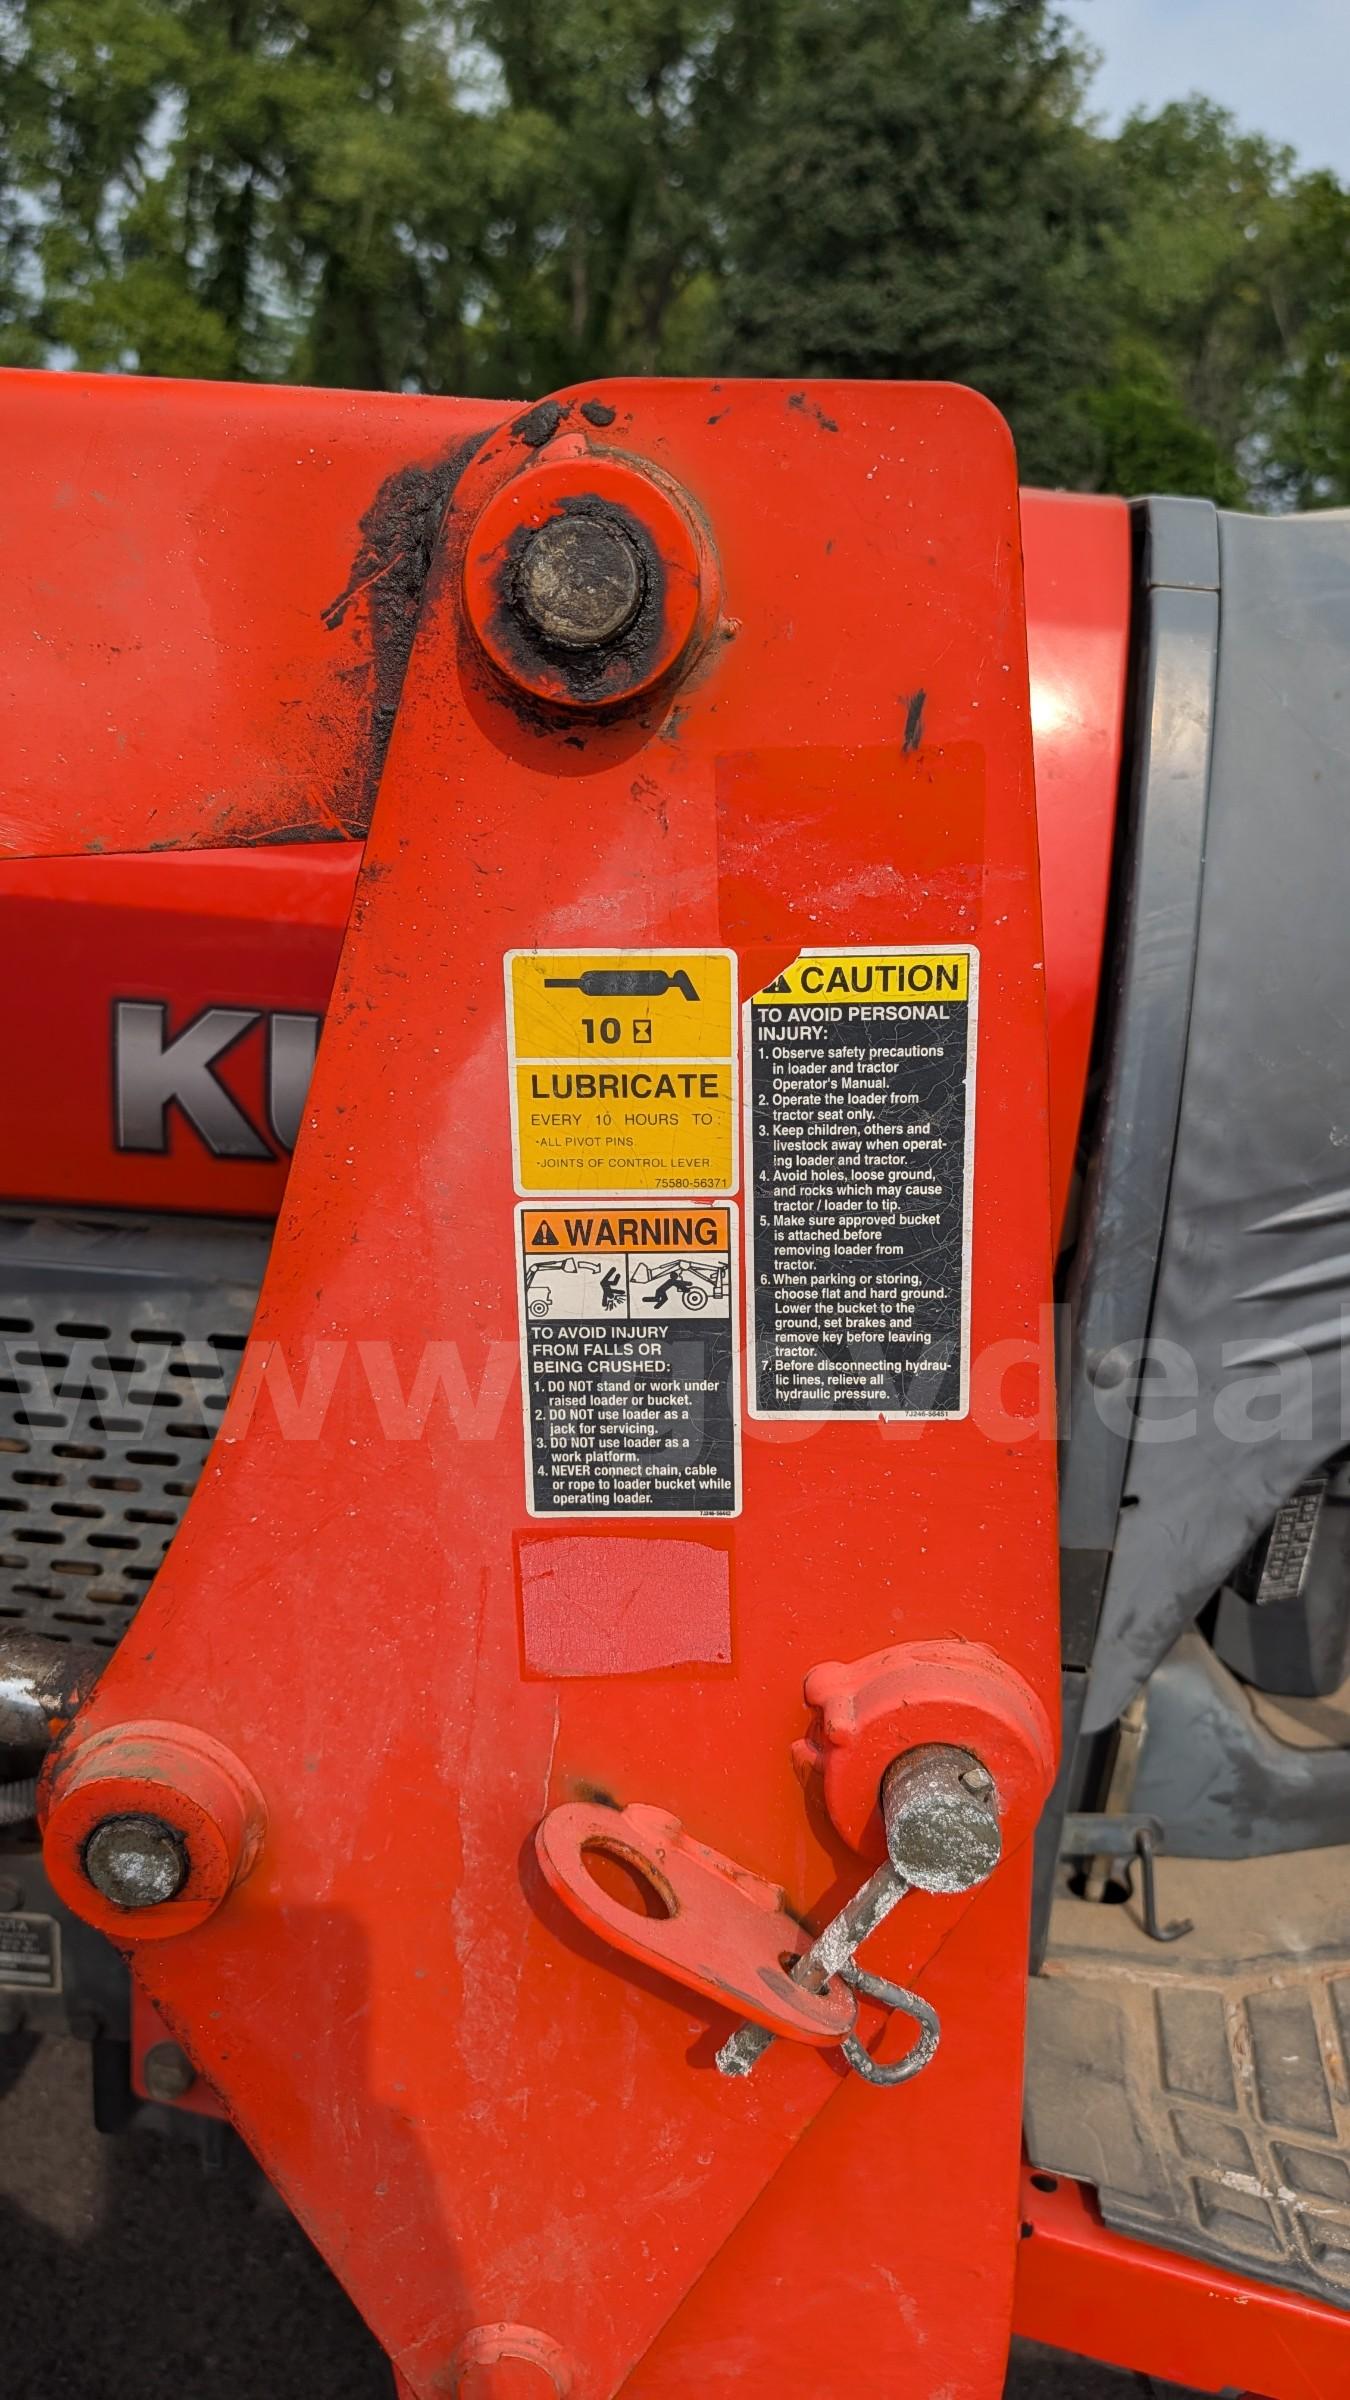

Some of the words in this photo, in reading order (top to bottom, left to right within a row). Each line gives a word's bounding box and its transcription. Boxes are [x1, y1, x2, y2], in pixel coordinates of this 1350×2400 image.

[800, 964, 959, 993] CAUTION
[758, 1008, 782, 1022] TO
[788, 1008, 842, 1022] AVOID
[849, 1006, 949, 1021] PERSONAL
[581, 1018, 621, 1044] 10
[758, 1026, 828, 1041] INJURY:
[772, 1047, 824, 1059] Observe
[828, 1046, 865, 1060] safety
[869, 1045, 944, 1060] precautions
[773, 1063, 783, 1074] in
[788, 1063, 827, 1074] loader
[830, 1062, 853, 1073] and
[857, 1062, 899, 1073] tractor
[532, 1074, 719, 1098] LUBRICATE
[773, 1078, 837, 1091] Operator's
[842, 1078, 890, 1089] Manual.
[772, 1094, 821, 1107] Operate
[825, 1094, 845, 1105] the
[848, 1093, 888, 1104] loader
[890, 1093, 919, 1104] from
[531, 1114, 581, 1126] EVERY
[596, 1114, 611, 1126] 10
[625, 1114, 679, 1126] HOURS
[773, 1110, 814, 1121] tractor
[817, 1110, 843, 1121] seat
[847, 1109, 875, 1122] only.
[773, 1125, 804, 1139] Keep
[808, 1125, 860, 1137] children,
[864, 1124, 903, 1135] others
[907, 1123, 930, 1134] and
[565, 1137, 600, 1147] PIVOT
[774, 1140, 828, 1151] livestock
[831, 1141, 862, 1153] away
[866, 1140, 899, 1150] when
[903, 1139, 947, 1152] operat-
[588, 1158, 605, 1168] OF
[609, 1158, 666, 1168] CONTROL
[774, 1155, 792, 1168] ing
[796, 1155, 834, 1166] loader
[838, 1155, 861, 1166] and
[864, 1155, 908, 1165] tractor.
[773, 1171, 807, 1182] Avoid
[811, 1170, 848, 1182] holes,
[851, 1170, 885, 1181] loose
[888, 1169, 935, 1183] ground,
[655, 1179, 727, 1188] 75580-56371
[774, 1185, 796, 1196] and
[800, 1185, 833, 1195] rocks
[837, 1184, 873, 1195] which
[876, 1186, 901, 1198] may
[905, 1185, 942, 1195] cause
[774, 1200, 814, 1211] tractor
[824, 1200, 862, 1210] loader
[866, 1200, 878, 1210] to
[882, 1200, 900, 1212] tip.
[774, 1215, 805, 1226] Make
[809, 1217, 835, 1225] sure
[839, 1215, 895, 1229] approved
[900, 1214, 941, 1225] bucket
[564, 1218, 718, 1245] WARNING
[774, 1230, 784, 1241] is
[788, 1230, 841, 1241] attached
[843, 1229, 882, 1240] before
[774, 1245, 831, 1258] removing
[834, 1244, 872, 1254] loader
[876, 1244, 904, 1254] from
[774, 1260, 816, 1270] tractor.
[773, 1274, 807, 1284] When
[811, 1274, 855, 1287] parking
[860, 1276, 873, 1284] or
[876, 1274, 922, 1287] storing,
[775, 1289, 818, 1299] choose
[822, 1289, 841, 1299] flat
[844, 1288, 866, 1298] and
[870, 1288, 897, 1298] hard
[900, 1288, 948, 1301] ground.
[775, 1303, 811, 1314] Lower
[815, 1303, 834, 1314] the
[837, 1303, 877, 1313] bucket
[881, 1303, 892, 1313] to
[896, 1303, 915, 1313] the
[775, 1318, 821, 1330] ground,
[824, 1318, 843, 1328] set
[846, 1318, 886, 1328] brakes
[889, 1317, 911, 1327] and
[531, 1327, 554, 1339] TO
[558, 1327, 607, 1339] AVOID
[611, 1326, 669, 1339] INJURY
[775, 1333, 819, 1343] remove
[823, 1332, 843, 1345] key
[846, 1332, 885, 1342] before
[889, 1332, 931, 1344] leaving
[532, 1344, 580, 1356] FROM
[584, 1344, 633, 1356] FALLS
[638, 1344, 661, 1355] OR
[776, 1346, 817, 1357] tractor.
[533, 1361, 583, 1373] BEING
[588, 1361, 671, 1373] CRUSHED:
[775, 1360, 814, 1371] Before
[817, 1360, 902, 1373] disconnecting
[905, 1360, 951, 1373] hydrau-
[548, 1381, 564, 1392] DO
[569, 1381, 593, 1392] NOT
[597, 1381, 630, 1392] stand
[634, 1383, 647, 1392] or
[650, 1381, 681, 1391] work
[684, 1380, 719, 1391] under
[776, 1375, 789, 1385] lic
[793, 1375, 824, 1386] lines,
[827, 1375, 867, 1385] relieve
[870, 1374, 884, 1384] all
[549, 1395, 586, 1406] raised
[590, 1395, 629, 1406] loader
[632, 1397, 644, 1406] or
[648, 1394, 692, 1406] bucket.
[776, 1389, 830, 1401] hydraulic
[834, 1390, 890, 1400] pressure.
[550, 1409, 566, 1421] DO
[570, 1409, 593, 1421] NOT
[598, 1412, 619, 1421] use
[623, 1409, 660, 1420] loader
[664, 1411, 678, 1420] as
[550, 1423, 575, 1435] jack
[579, 1423, 596, 1434] for
[599, 1423, 658, 1435] servicing.
[550, 1437, 566, 1448] DO
[570, 1437, 595, 1448] NOT
[599, 1439, 620, 1448] use
[623, 1437, 661, 1448] loader
[665, 1439, 678, 1448] as
[552, 1451, 581, 1462] work
[586, 1451, 640, 1464] platform.
[552, 1465, 590, 1476] NEVER
[594, 1466, 642, 1476] connect
[645, 1465, 682, 1478] chain,
[685, 1465, 717, 1475] cable
[553, 1481, 565, 1490] or
[569, 1481, 595, 1492] rope
[614, 1479, 651, 1490] loader
[655, 1479, 695, 1489] bucket
[699, 1478, 731, 1489] while
[553, 1493, 609, 1506] operating
[613, 1493, 653, 1504] loader.
